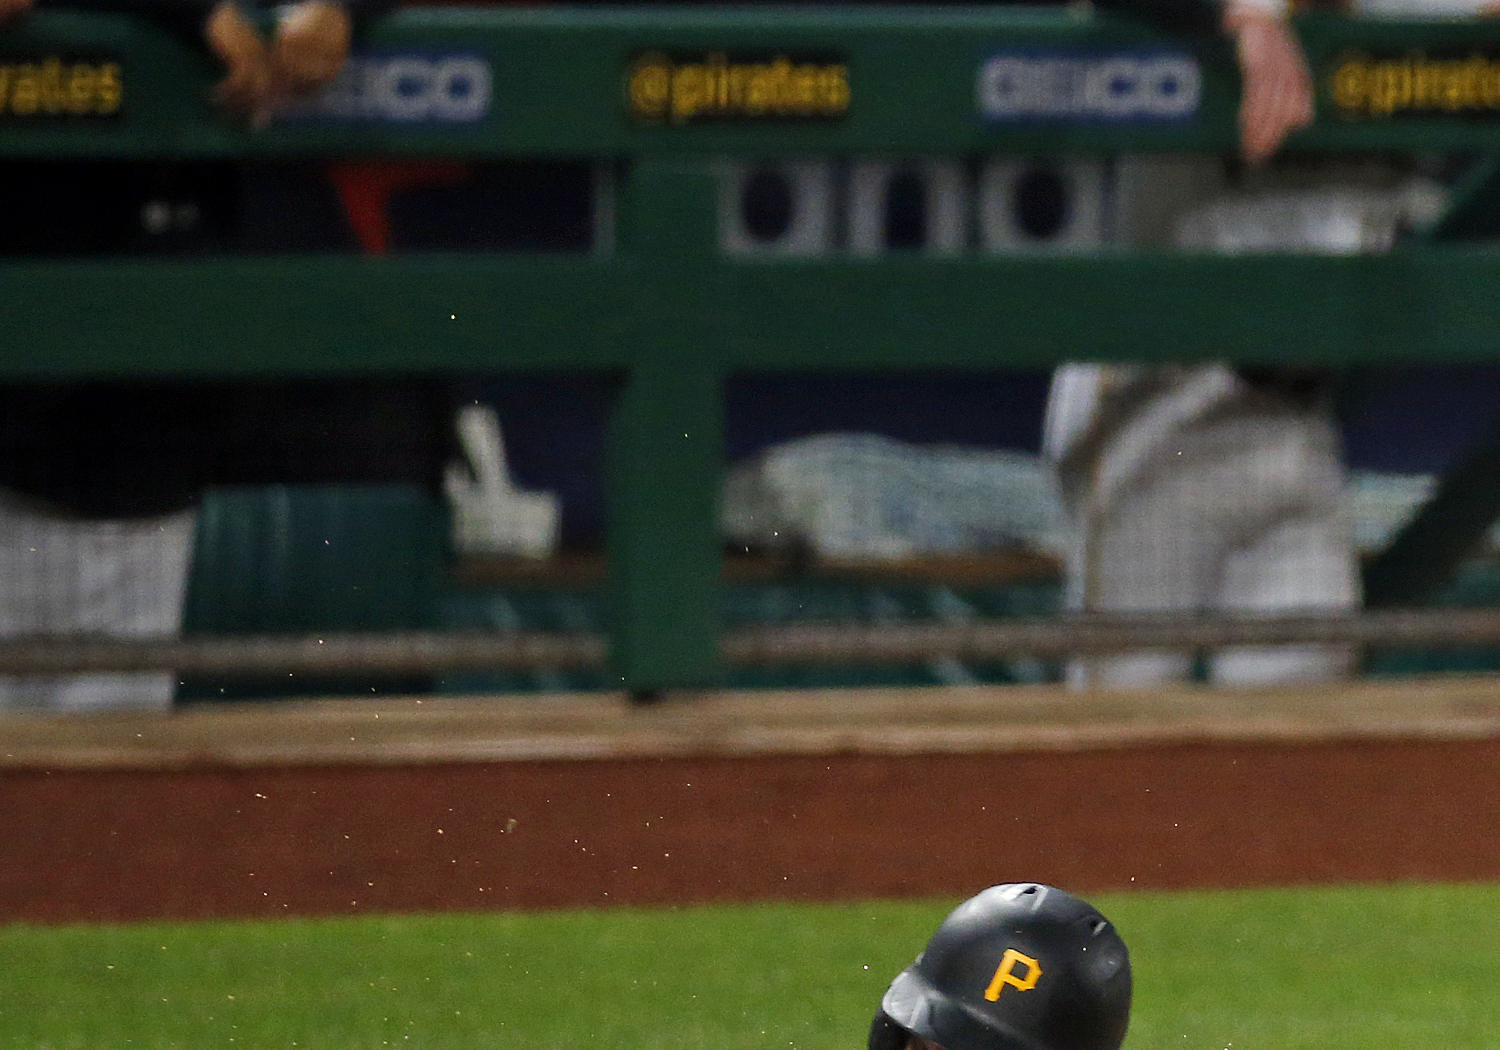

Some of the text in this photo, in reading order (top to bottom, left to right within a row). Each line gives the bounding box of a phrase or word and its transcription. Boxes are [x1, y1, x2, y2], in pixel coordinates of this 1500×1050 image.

[628, 50, 850, 124] @pirates
[976, 54, 1199, 118] GEICO
[985, 948, 1043, 1002] P
